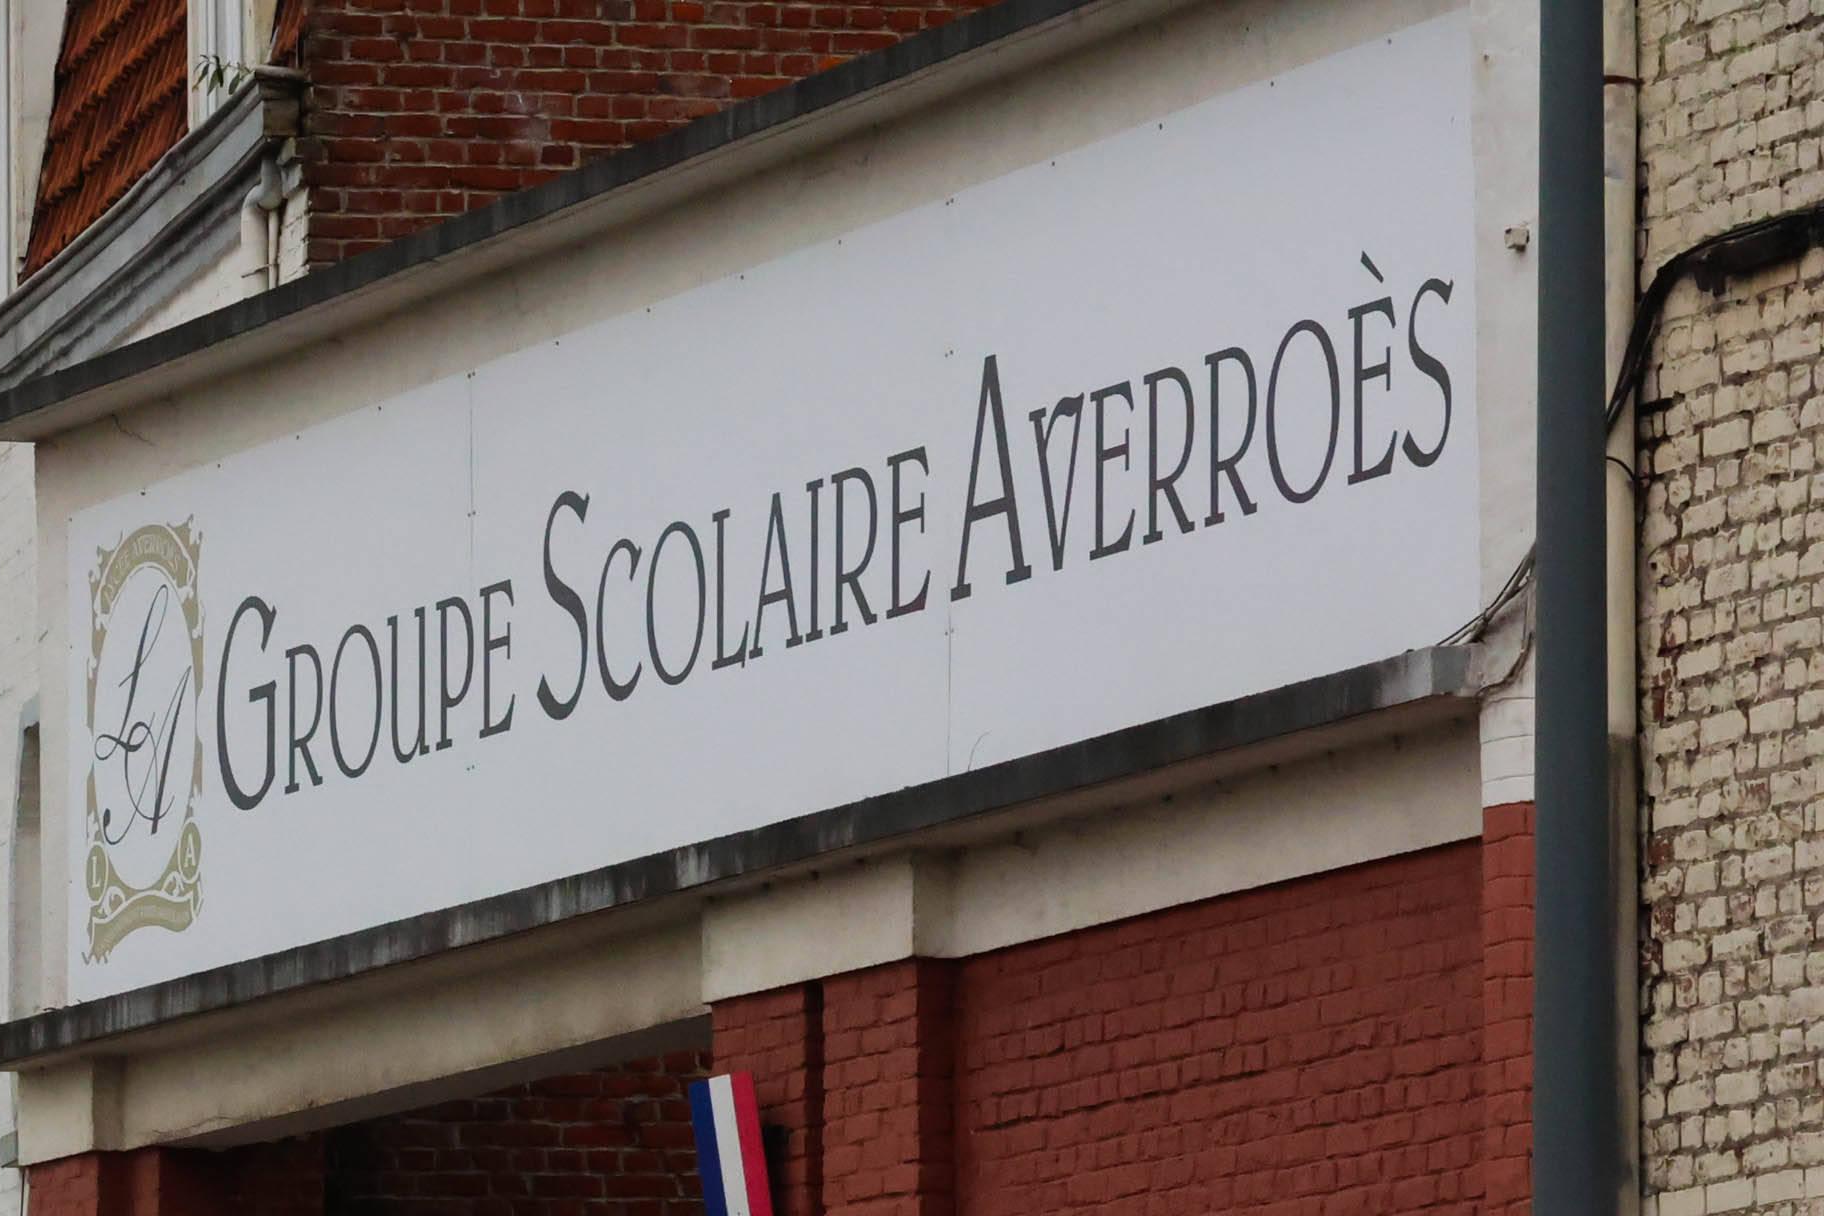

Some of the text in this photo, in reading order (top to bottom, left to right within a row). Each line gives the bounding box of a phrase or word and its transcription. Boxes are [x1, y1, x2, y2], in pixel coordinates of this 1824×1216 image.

[215, 250, 1455, 812] GROUPE SCOLAIRE AVERROÈS
